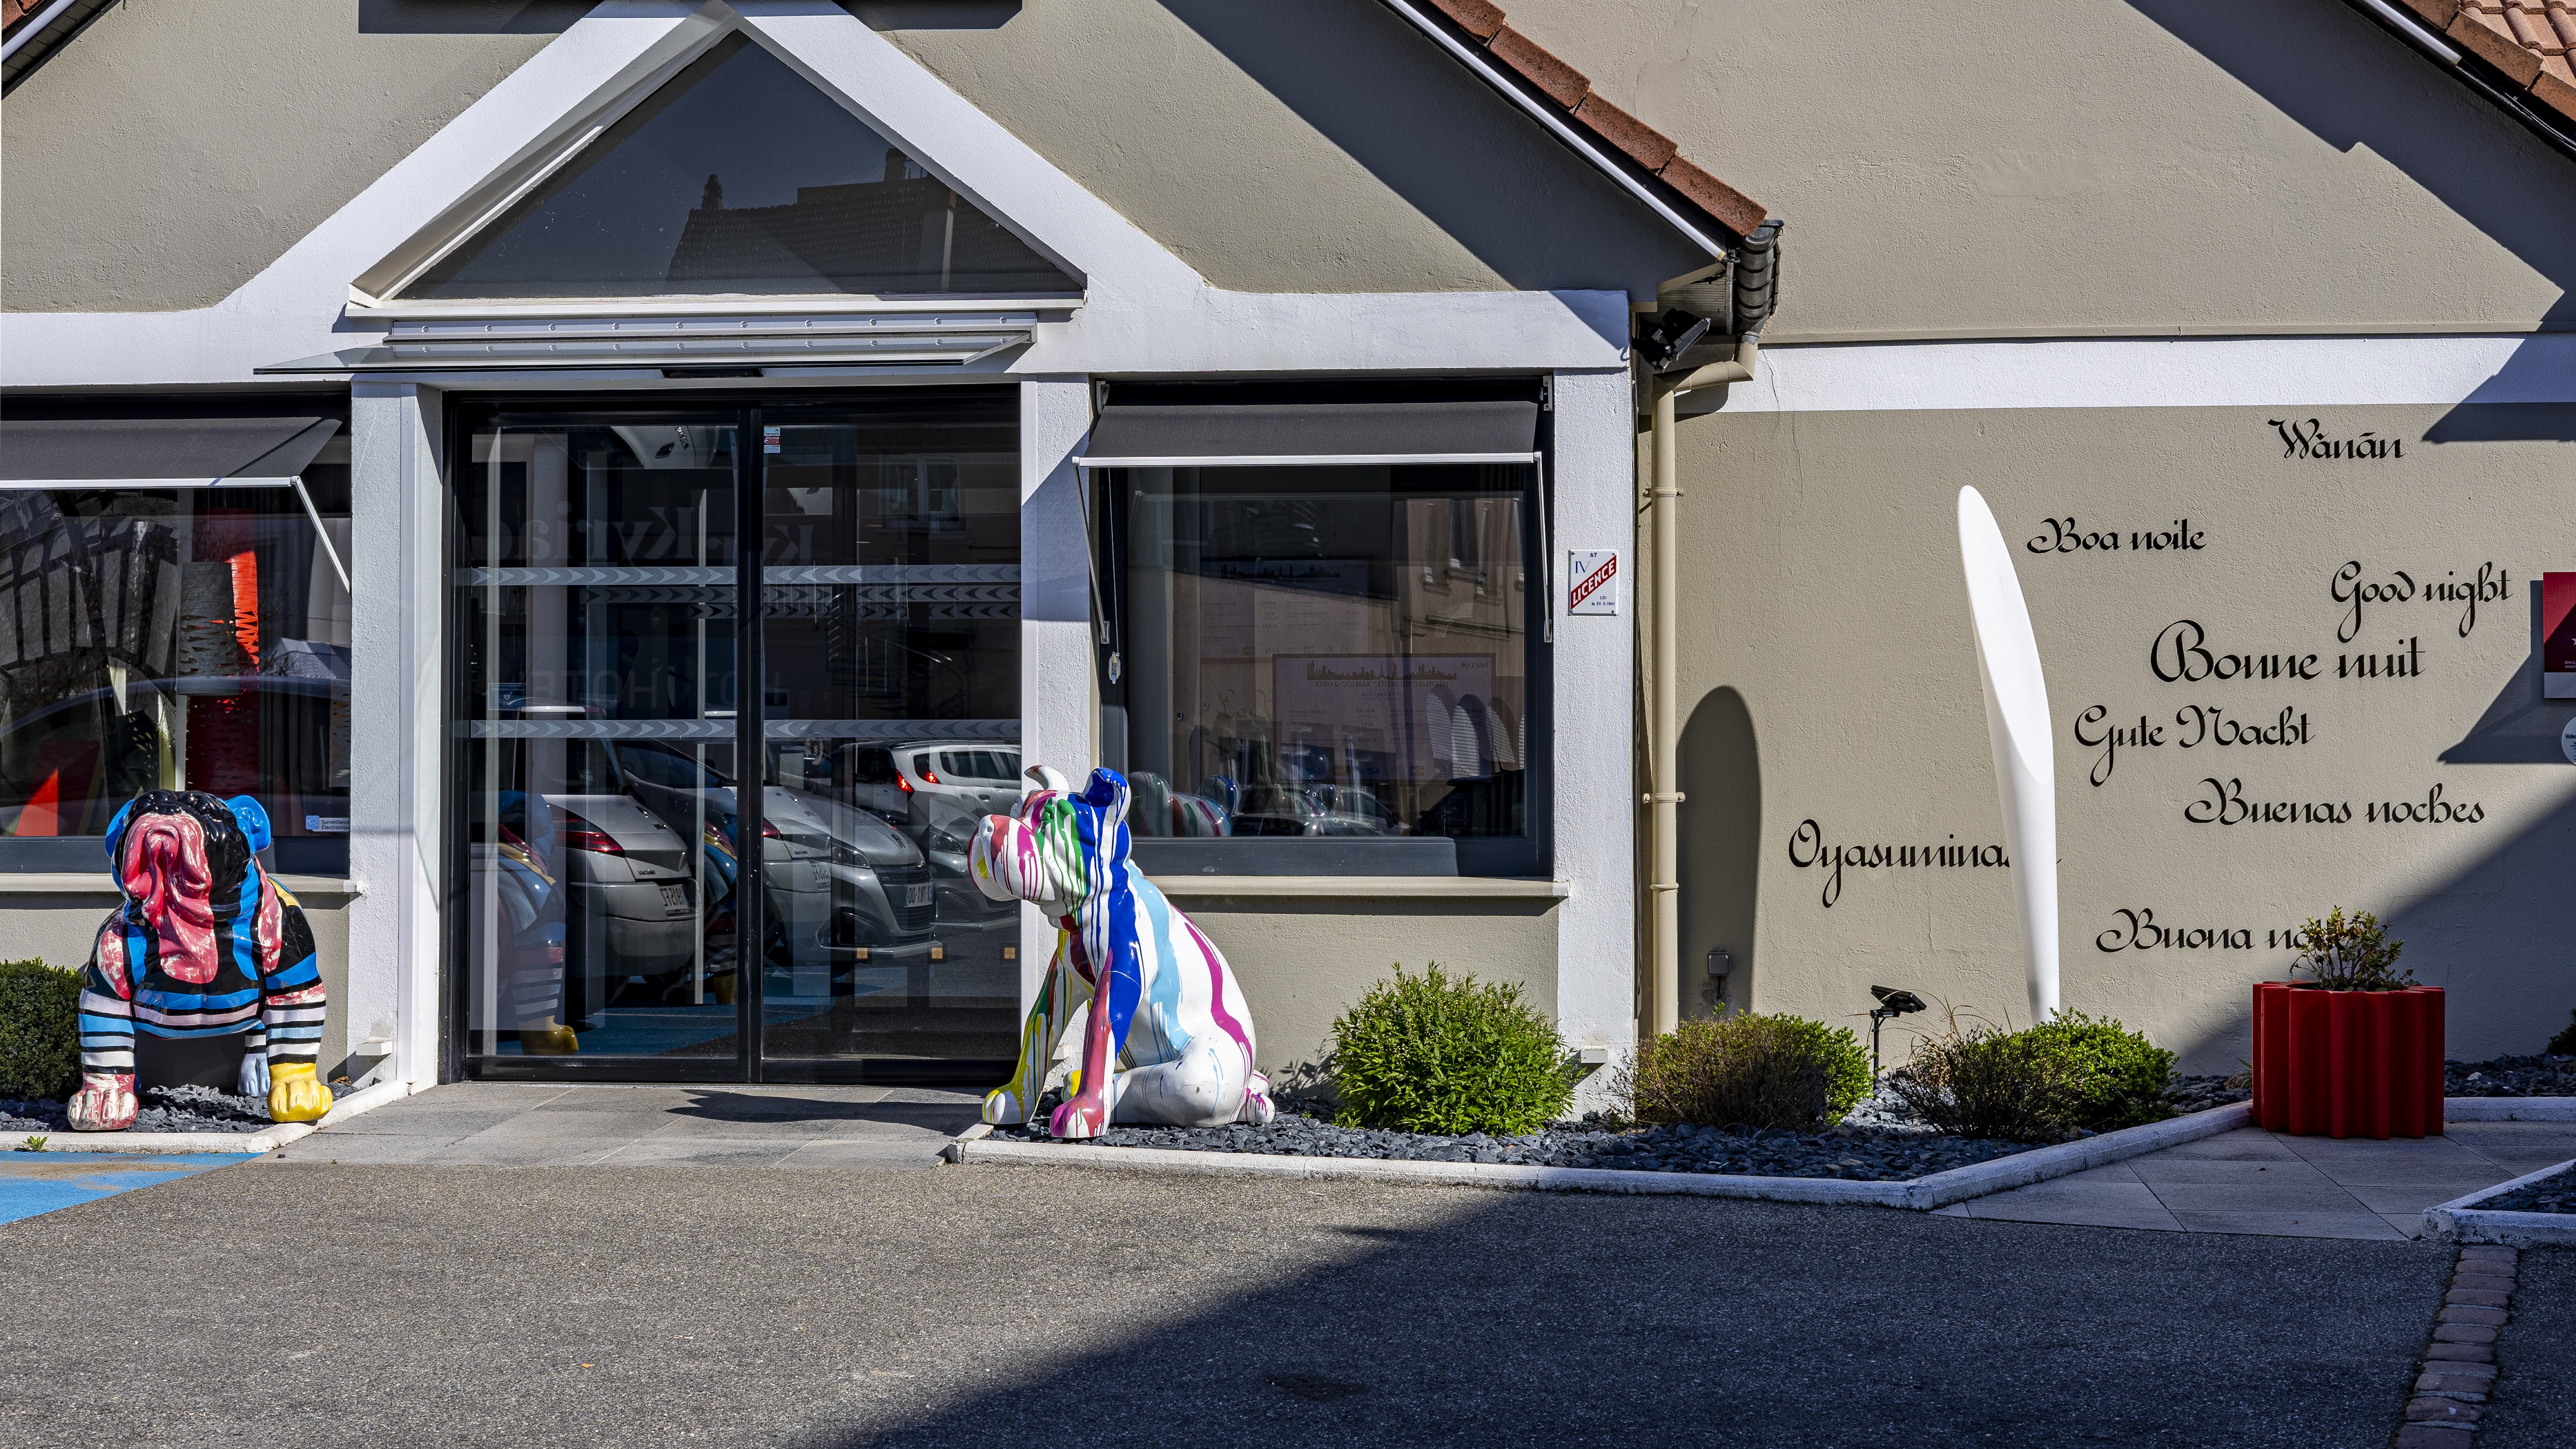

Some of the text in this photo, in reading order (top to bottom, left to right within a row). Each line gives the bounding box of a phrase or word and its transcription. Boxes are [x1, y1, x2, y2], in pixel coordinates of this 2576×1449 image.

[2027, 518, 2207, 554] Boa noite
[1573, 559, 1615, 606] LICENCE
[1575, 560, 1590, 573] IV
[2331, 560, 2513, 644] Good night
[1461, 661, 1488, 670] Kyriad
[2150, 619, 2426, 682] Bonne nuit
[2075, 705, 2316, 788] Gute Nacht
[2184, 778, 2485, 826] Buenas noches
[2095, 908, 2254, 953] Buona
